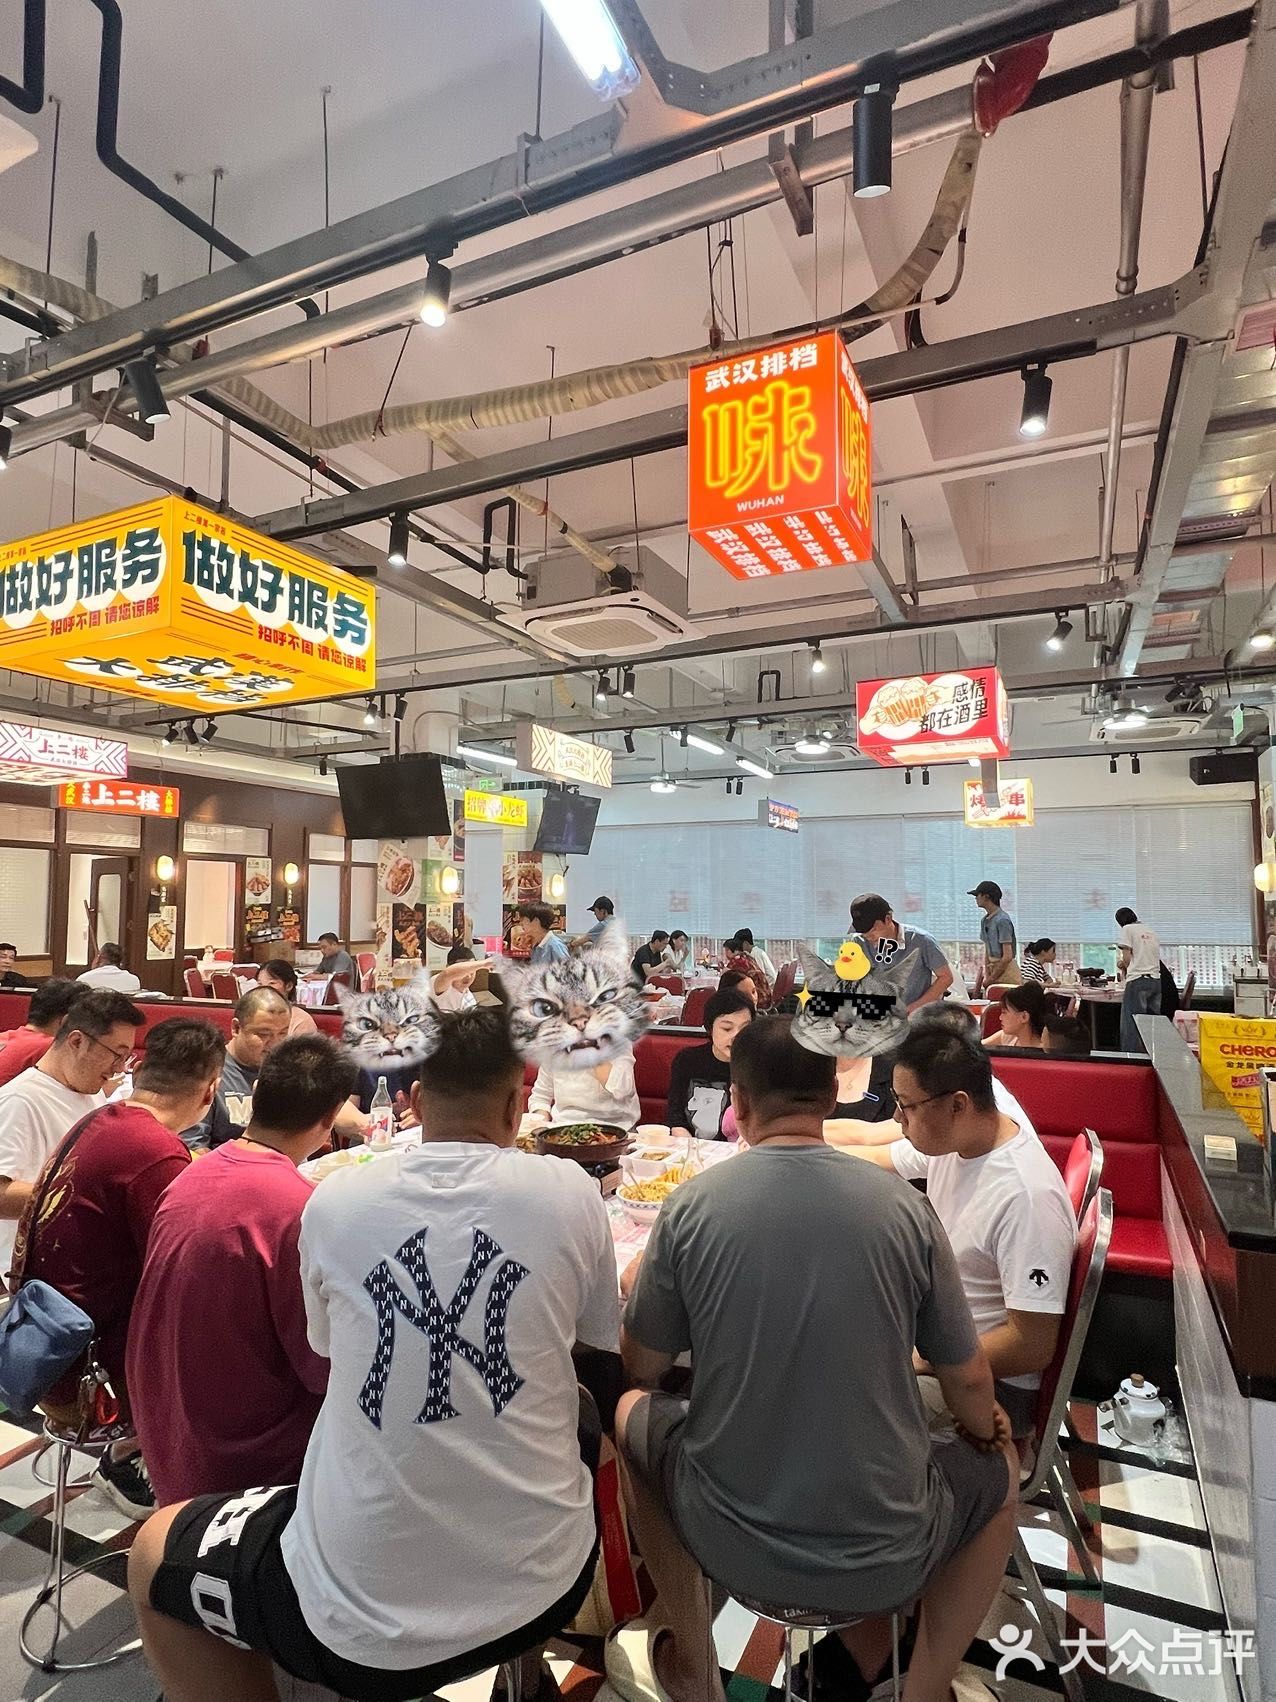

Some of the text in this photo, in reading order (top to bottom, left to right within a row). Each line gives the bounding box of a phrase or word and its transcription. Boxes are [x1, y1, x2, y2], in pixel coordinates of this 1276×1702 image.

[705, 344, 818, 392] 武汉排档
[737, 495, 785, 512] WUHAN
[0, 527, 163, 618] 做好服务
[182, 530, 368, 646] 做好服务
[50, 596, 160, 636] 招呼不周 请您谅解
[258, 625, 367, 672] 招呼不周 请您谅解
[952, 677, 987, 704] 感情
[920, 698, 988, 734] 都在酒里
[38, 738, 89, 761] 上二楼
[91, 784, 161, 811] 上二楼
[357, 1226, 531, 1430] NY
